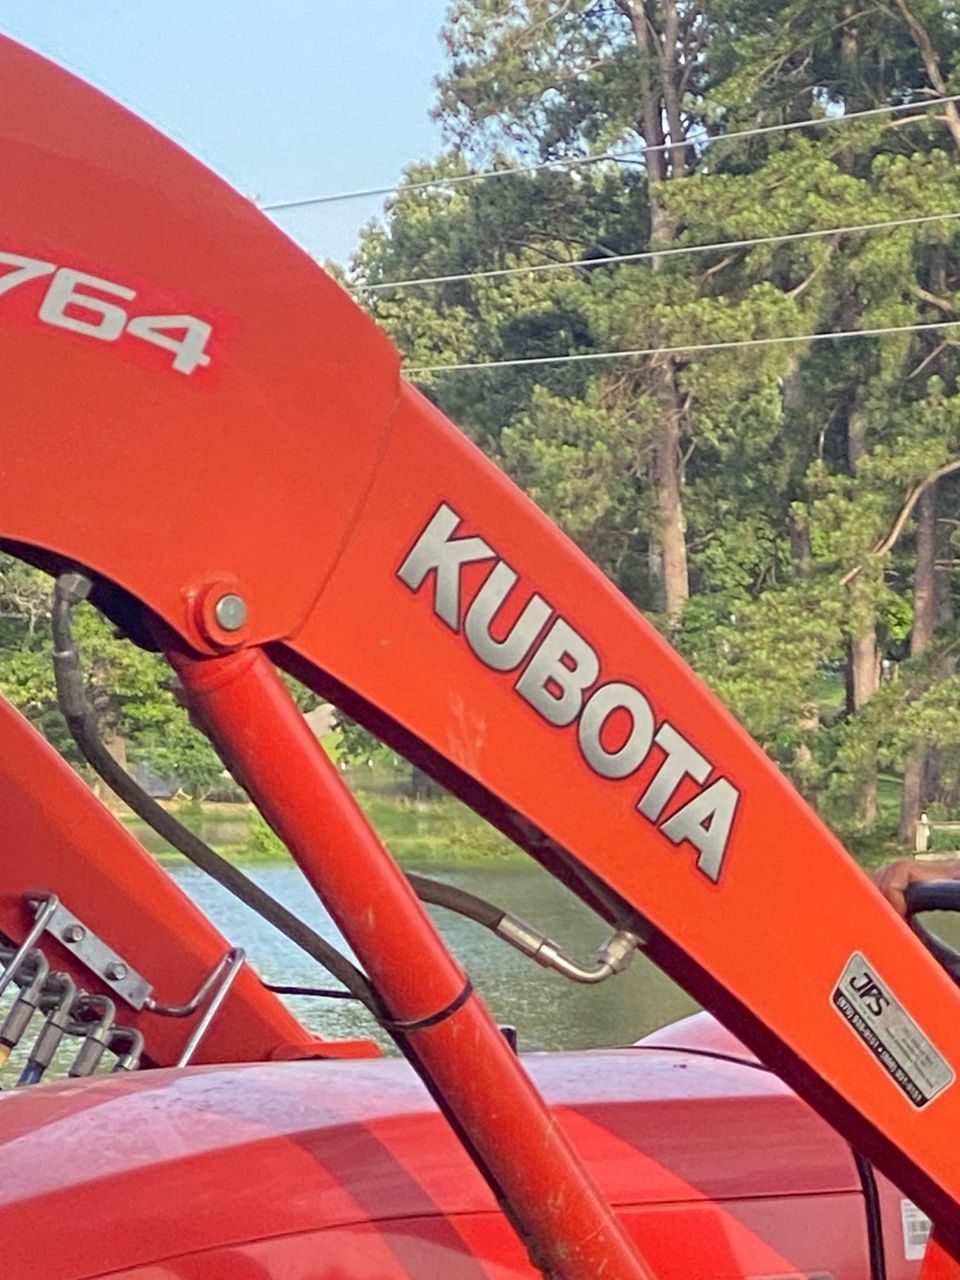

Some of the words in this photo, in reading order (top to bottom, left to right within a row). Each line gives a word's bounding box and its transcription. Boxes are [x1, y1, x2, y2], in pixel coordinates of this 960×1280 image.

[0, 251, 213, 375] 764
[396, 500, 742, 885] KUBOTA
[849, 972, 890, 1017] JPS
